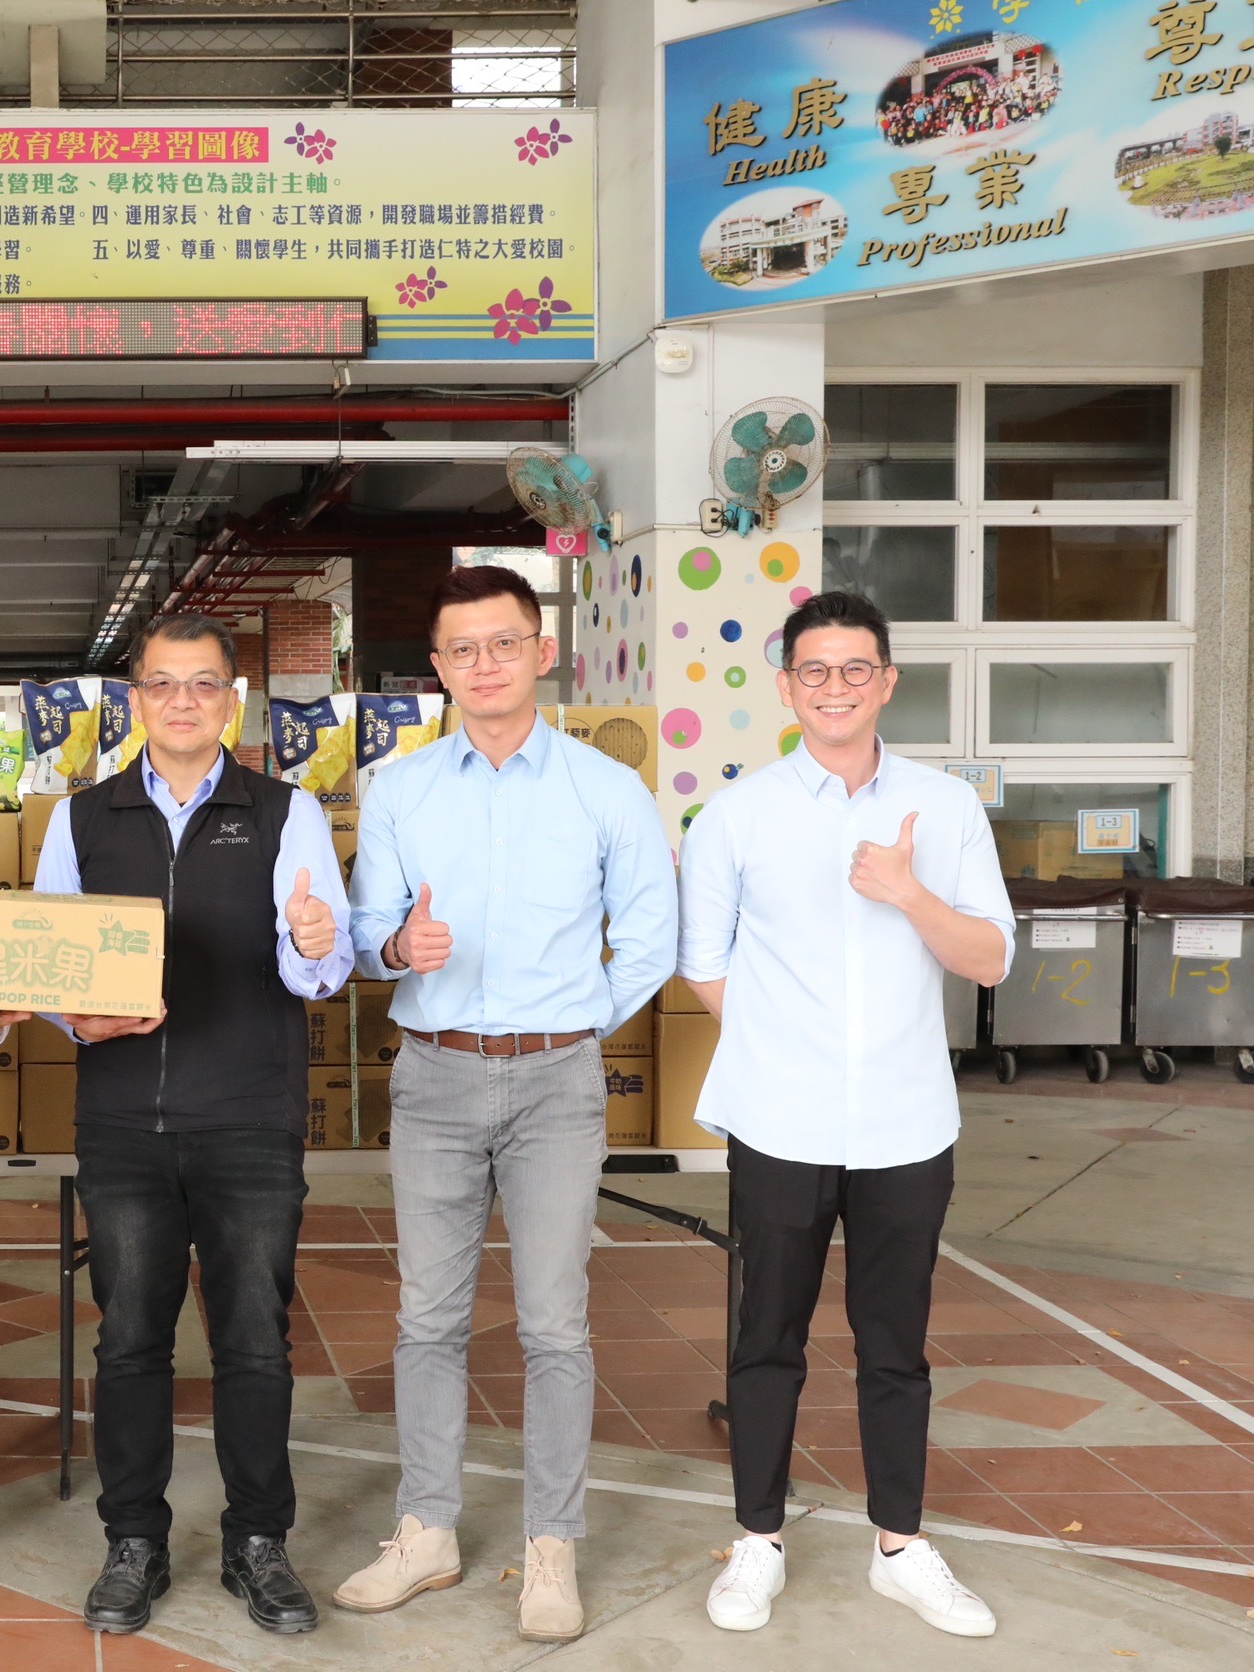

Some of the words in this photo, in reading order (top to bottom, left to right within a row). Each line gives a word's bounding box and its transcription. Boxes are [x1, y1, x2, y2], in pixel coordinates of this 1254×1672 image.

[1151, 63, 1254, 101] Resp
[703, 77, 848, 155] 健康
[722, 145, 826, 186] Health
[857, 207, 1069, 269] Professional
[965, 771, 982, 781] 1-2
[1101, 817, 1117, 827] 1-3
[1032, 959, 1092, 1006] 1-2
[1170, 955, 1231, 998] 1-3
[30, 993, 61, 1006] RICE
[310, 1012, 327, 1061] 蘇打餅
[310, 1097, 327, 1146] 蘇打餅
